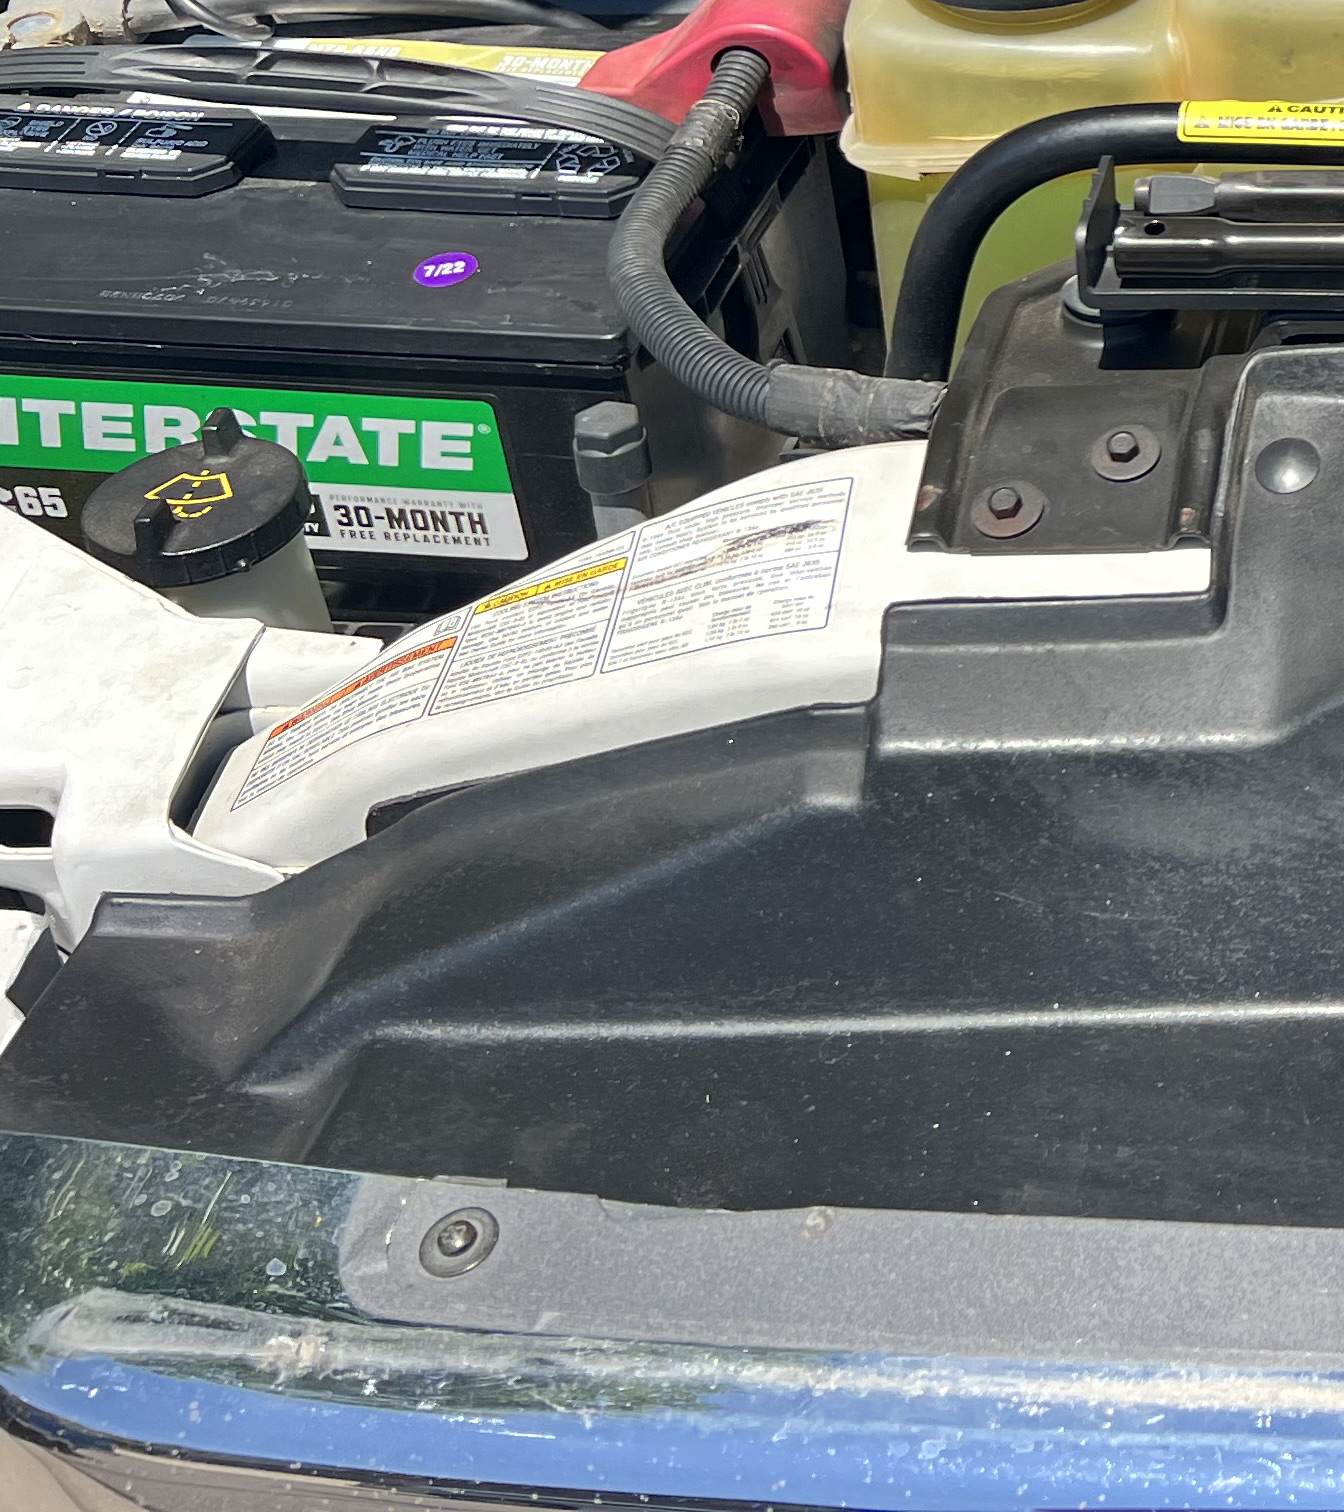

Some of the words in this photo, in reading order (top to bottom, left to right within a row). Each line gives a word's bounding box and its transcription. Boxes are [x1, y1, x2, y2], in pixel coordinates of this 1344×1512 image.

[422, 259, 467, 279] 7/22
[329, 494, 398, 506] PERFORMANCE
[402, 499, 455, 509] WARRANTY
[459, 501, 484, 510] WITH
[333, 503, 489, 535] 30-MONTH
[339, 529, 378, 541] FREE
[383, 531, 491, 547] REPLACEMENT
